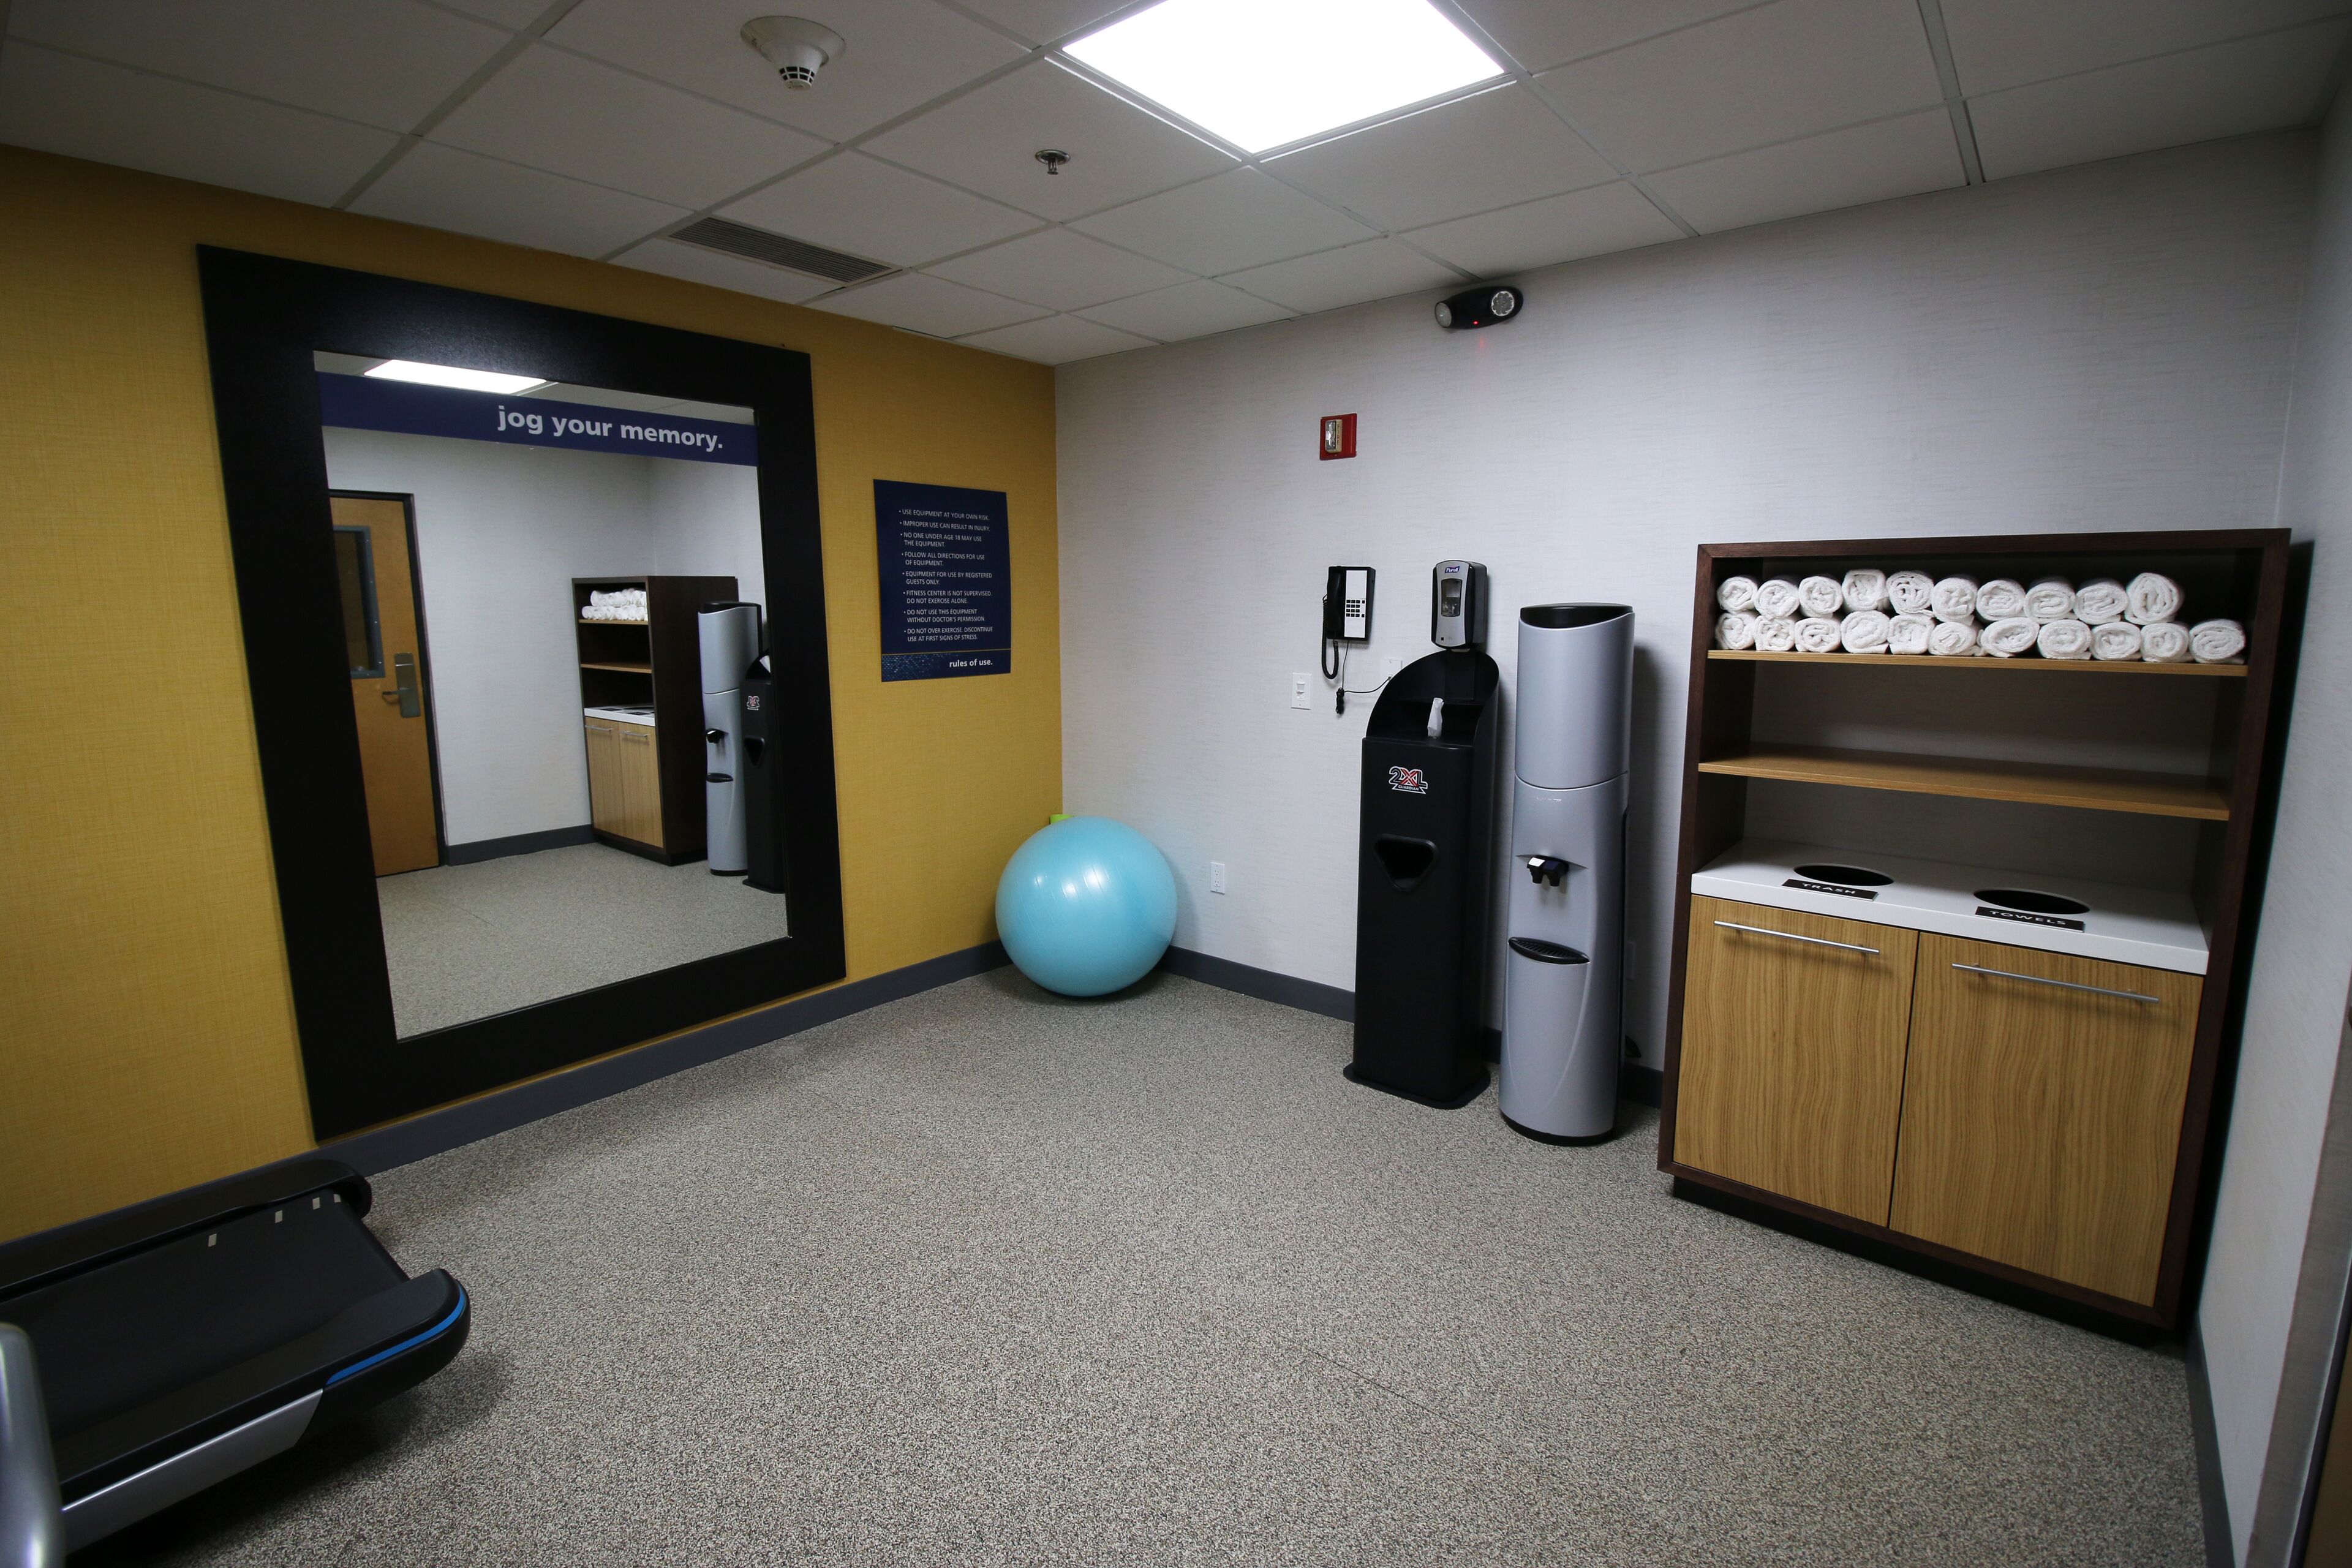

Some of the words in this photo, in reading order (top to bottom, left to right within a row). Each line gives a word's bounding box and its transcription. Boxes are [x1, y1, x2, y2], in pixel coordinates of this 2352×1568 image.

[497, 405, 543, 434] jog
[551, 416, 612, 437] your
[620, 424, 723, 452] memory.
[1389, 766, 1428, 789] 2XL
[1803, 883, 1855, 894] TRASH
[1989, 910, 2065, 925] TOWELS
